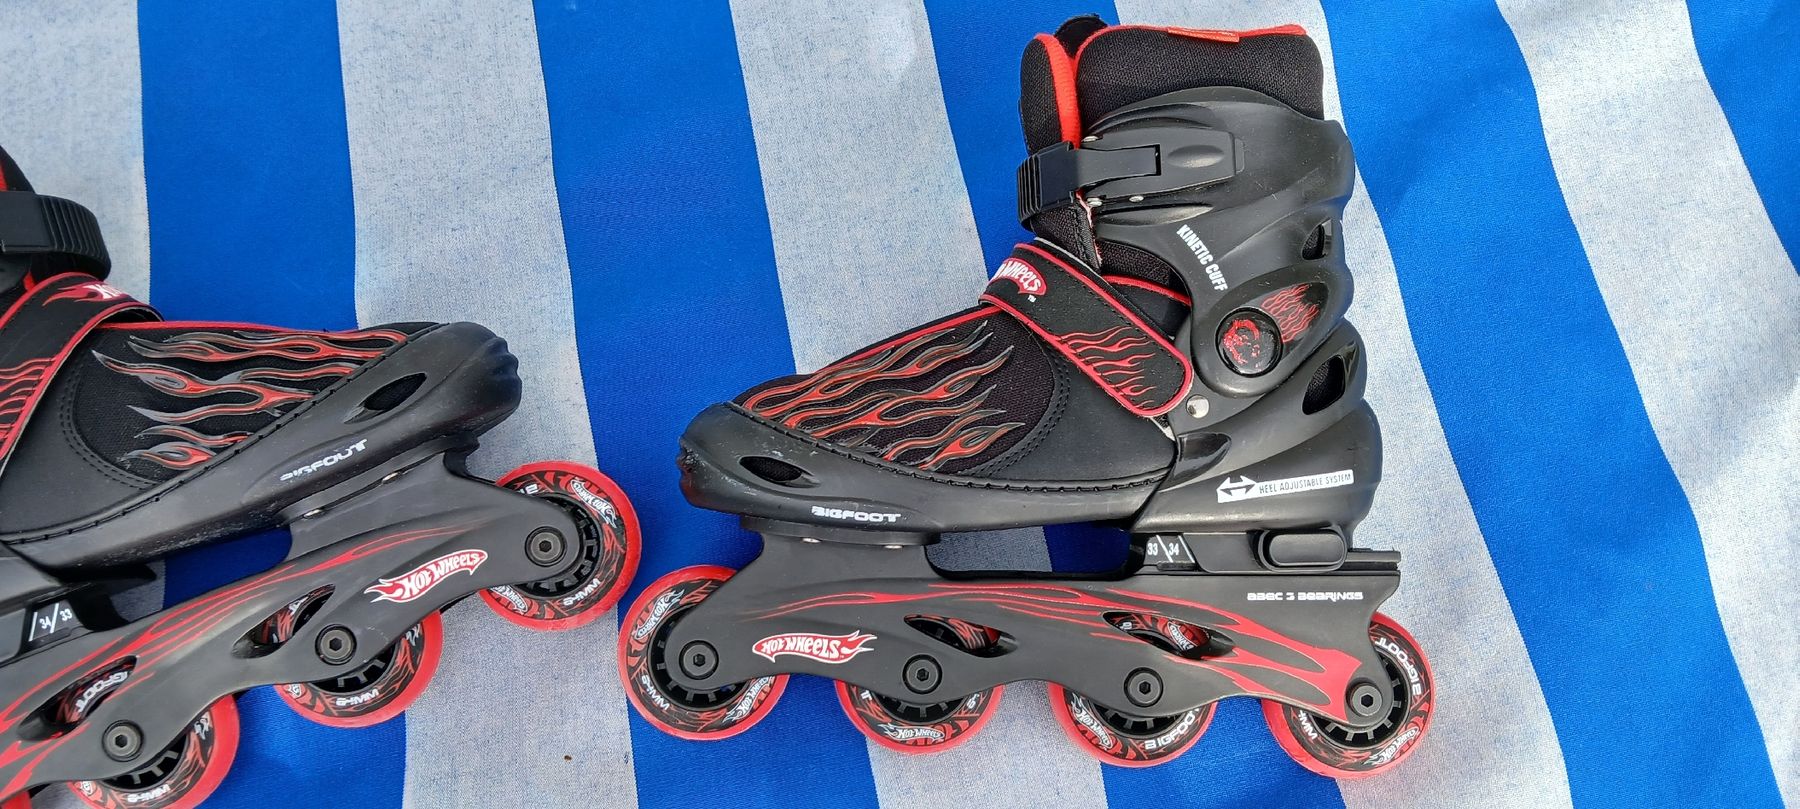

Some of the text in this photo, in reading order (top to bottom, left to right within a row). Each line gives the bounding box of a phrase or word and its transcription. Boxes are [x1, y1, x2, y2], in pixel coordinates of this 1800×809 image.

[1176, 224, 1229, 291] KINETIC CUFF
[1259, 473, 1352, 494] HEEL ADJUSTABLE SYSTEM
[811, 505, 902, 523] BIGFOOT
[1147, 542, 1180, 556] 33 34
[1297, 591, 1364, 602] BEARINGS
[39, 608, 73, 630] 34 33
[1374, 637, 1422, 696] BIGFOOT
